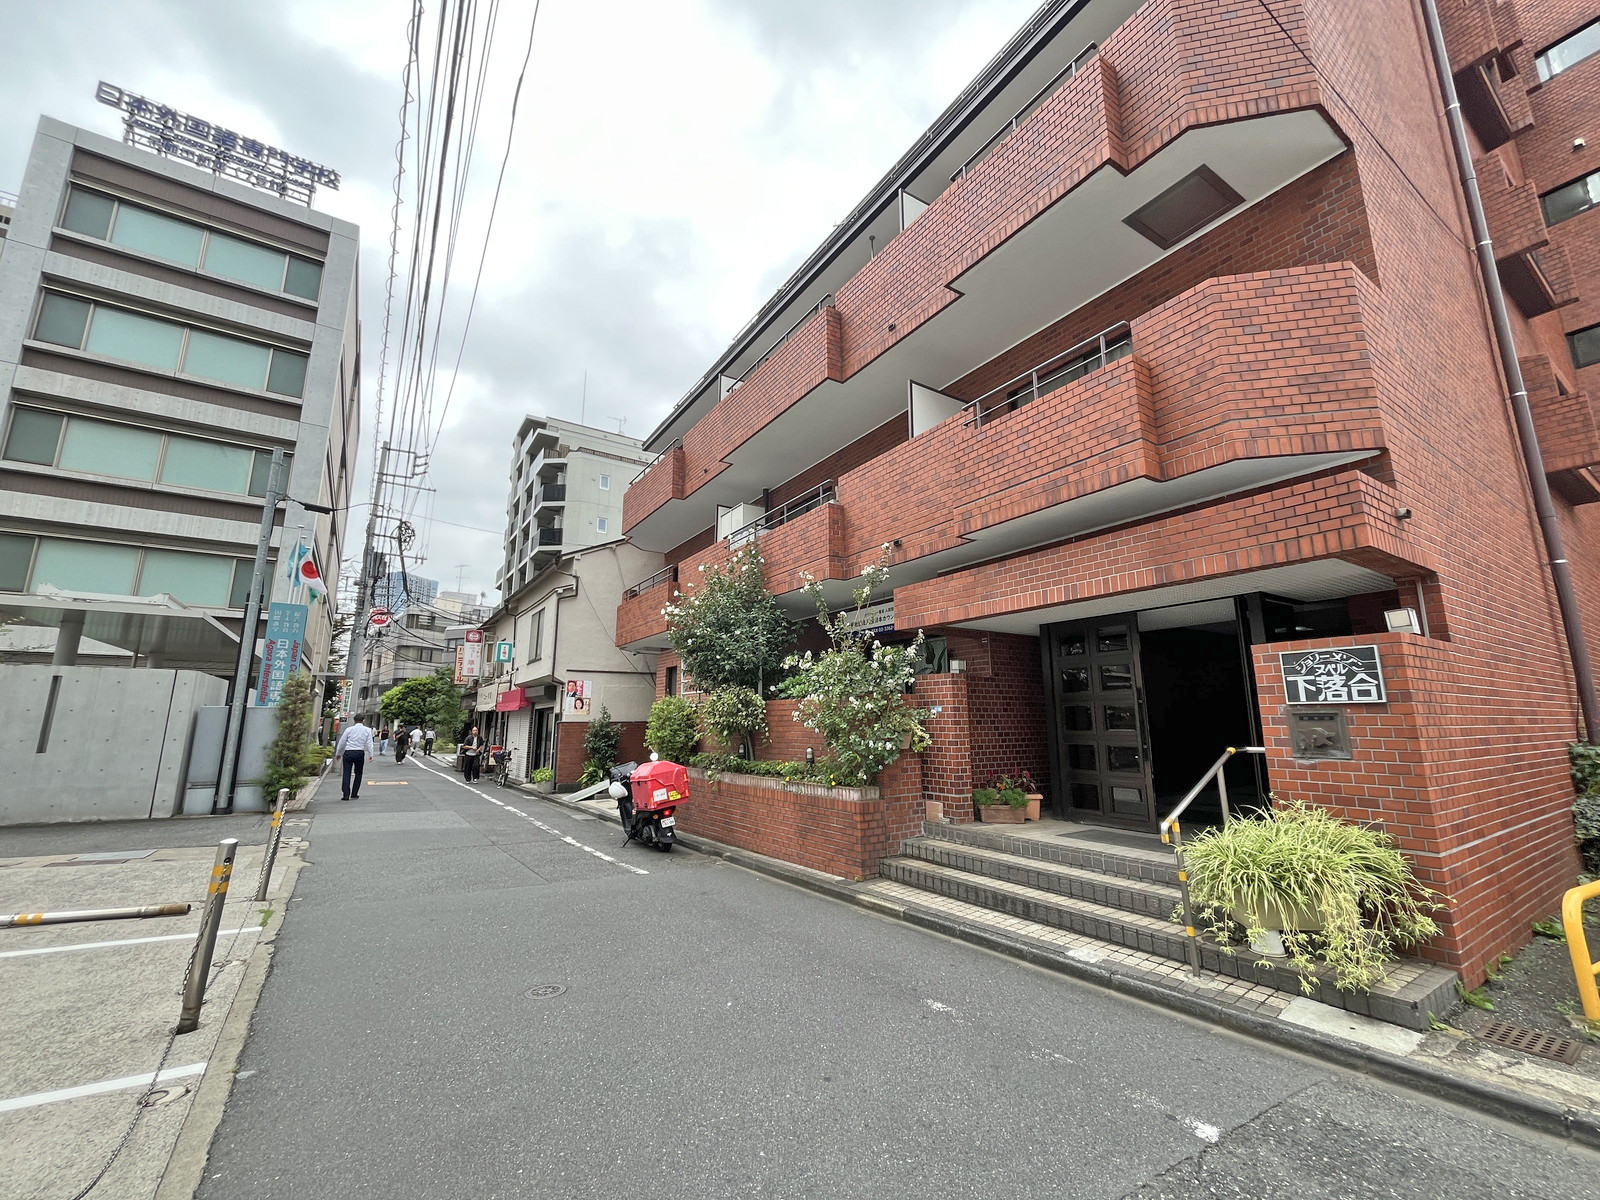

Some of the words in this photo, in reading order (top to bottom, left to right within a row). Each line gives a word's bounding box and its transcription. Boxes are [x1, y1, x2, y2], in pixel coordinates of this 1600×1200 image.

[265, 638, 276, 661] Agora
[1286, 673, 1379, 702] 下落合
